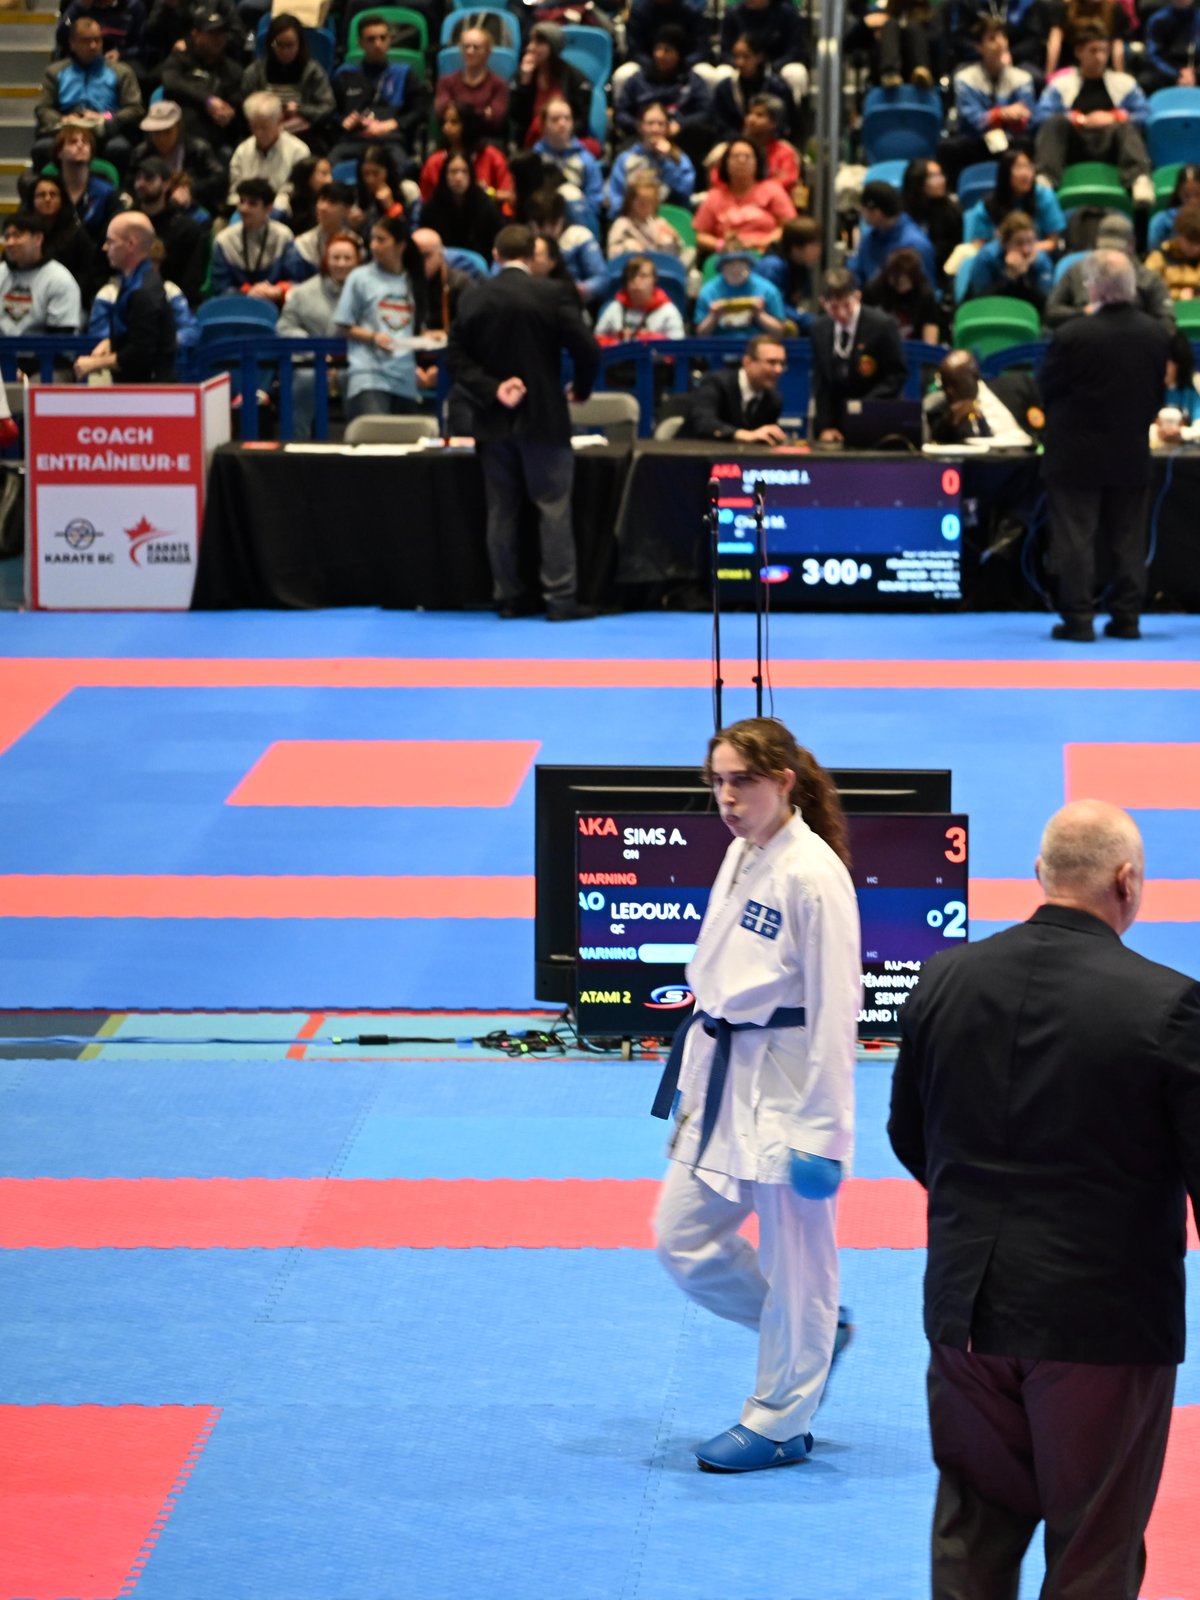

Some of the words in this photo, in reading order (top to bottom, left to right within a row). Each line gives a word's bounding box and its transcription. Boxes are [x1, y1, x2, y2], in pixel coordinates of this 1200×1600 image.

[77, 427, 153, 444] COACH
[941, 469, 960, 495] 0
[941, 514, 960, 540] 0
[147, 543, 189, 552] KARATE
[45, 553, 93, 564] KARATE
[98, 554, 114, 564] BC
[147, 554, 191, 564] CANADA
[623, 828, 666, 845] SIMS
[669, 828, 687, 845] A.
[944, 826, 966, 864] 3
[623, 849, 639, 860] ON
[611, 902, 680, 919] LEDOUX
[683, 902, 701, 920] A.
[610, 923, 625, 934] QC
[580, 991, 620, 1004] ATAMI
[623, 990, 631, 1004] 2
[856, 1008, 892, 1022] OUND
